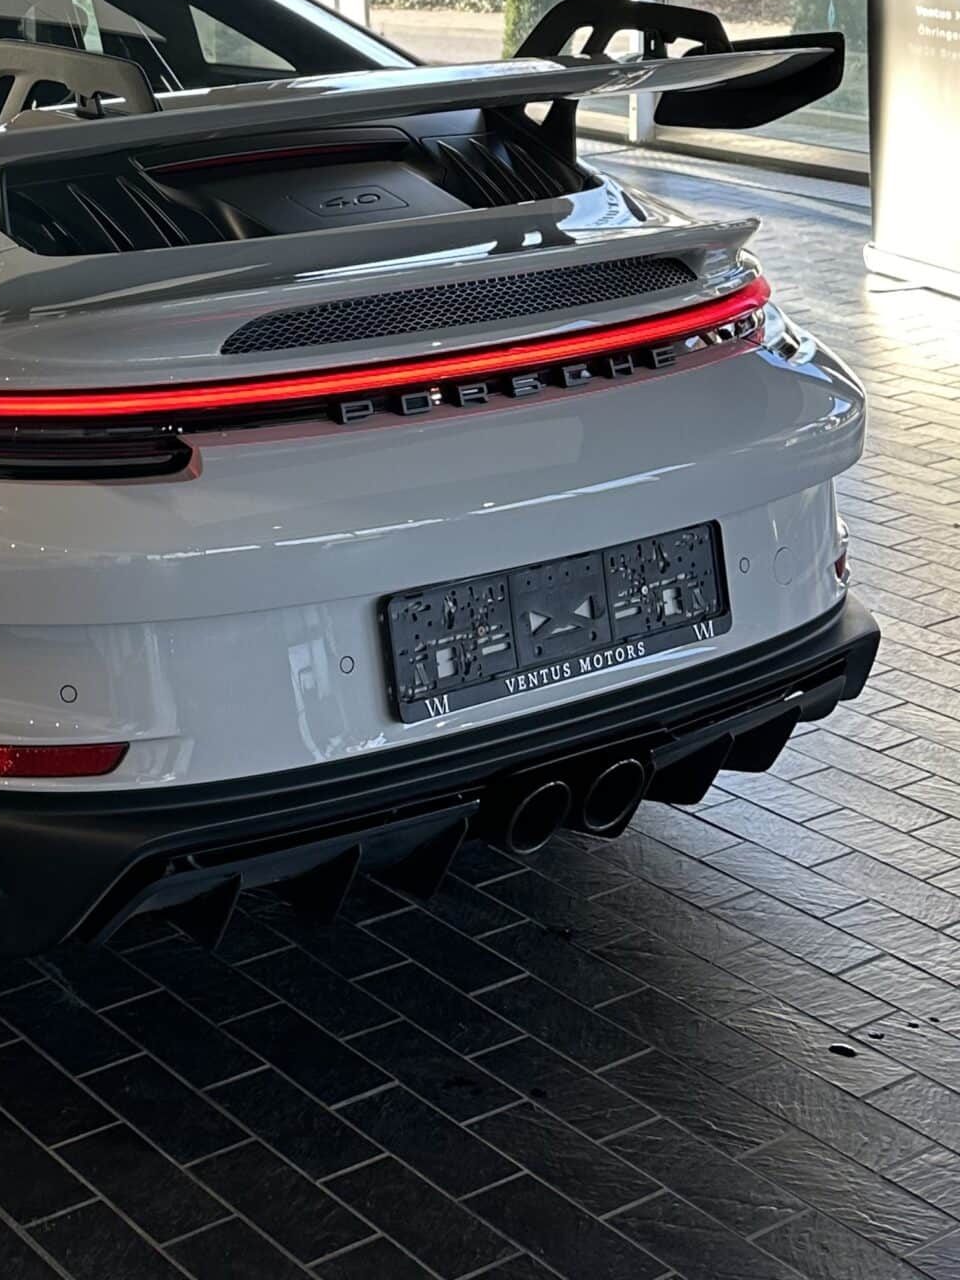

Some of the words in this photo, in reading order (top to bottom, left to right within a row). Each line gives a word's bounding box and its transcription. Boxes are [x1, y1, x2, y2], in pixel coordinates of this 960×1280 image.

[321, 192, 381, 209] 4.0
[339, 345, 676, 424] PORSCHE
[505, 663, 571, 694] VENTUS
[580, 641, 646, 673] MOTORS
